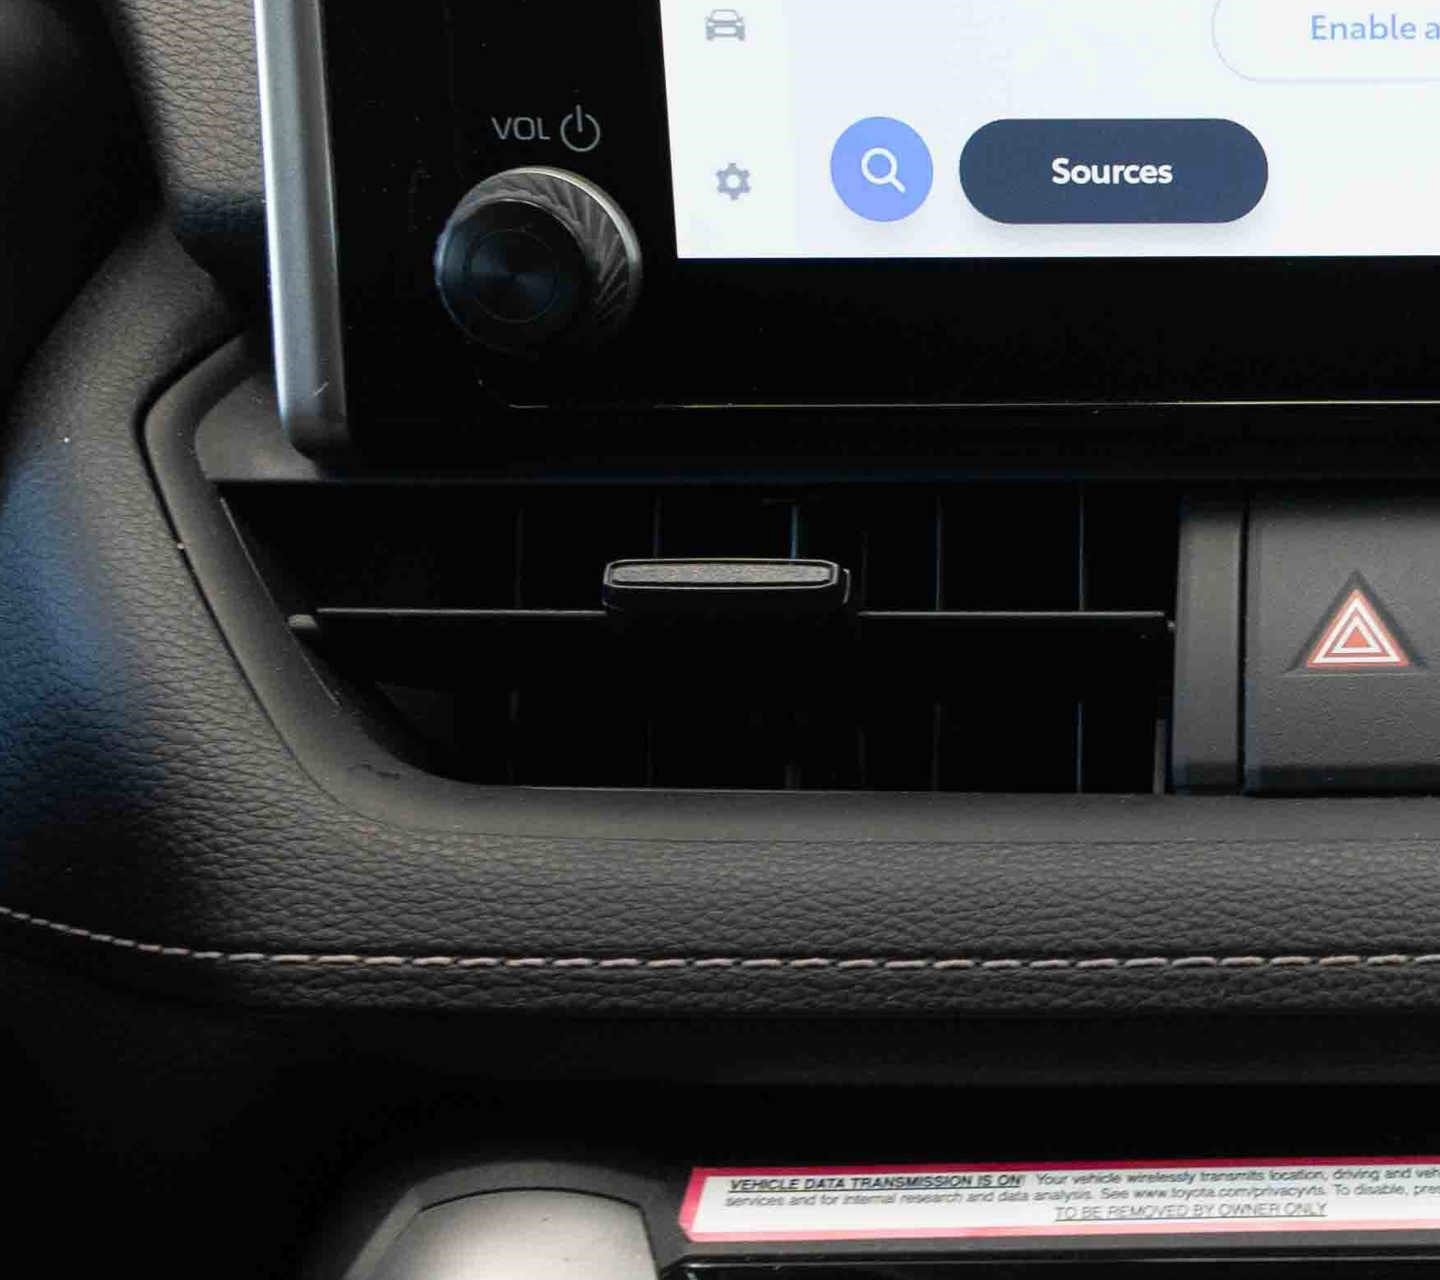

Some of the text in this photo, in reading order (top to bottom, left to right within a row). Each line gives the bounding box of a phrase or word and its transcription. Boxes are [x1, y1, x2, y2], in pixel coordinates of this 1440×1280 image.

[1310, 14, 1417, 42] Enable
[492, 116, 550, 141] VOL
[1051, 157, 1173, 186] Sources
[730, 1178, 800, 1192] VEHICLE
[803, 1177, 845, 1191] DATA
[850, 1175, 973, 1190] TRANSMISSION
[977, 1174, 993, 1187] IS
[1036, 1172, 1069, 1186] Your
[1072, 1171, 1121, 1185] vehicle
[1127, 1170, 1196, 1186] wirelessly
[1200, 1170, 1265, 1183] transmits
[1333, 1166, 1380, 1182] driving
[1384, 1166, 1411, 1180] and
[725, 1195, 785, 1208] services
[788, 1194, 817, 1207] and
[819, 1193, 839, 1207] for
[966, 1191, 994, 1204] and
[998, 1190, 1030, 1203] data
[1100, 1187, 1129, 1200] See
[1333, 1183, 1350, 1196] To
[1054, 1201, 1327, 1219] TO BE REMOVED BY OWNER ONLY
